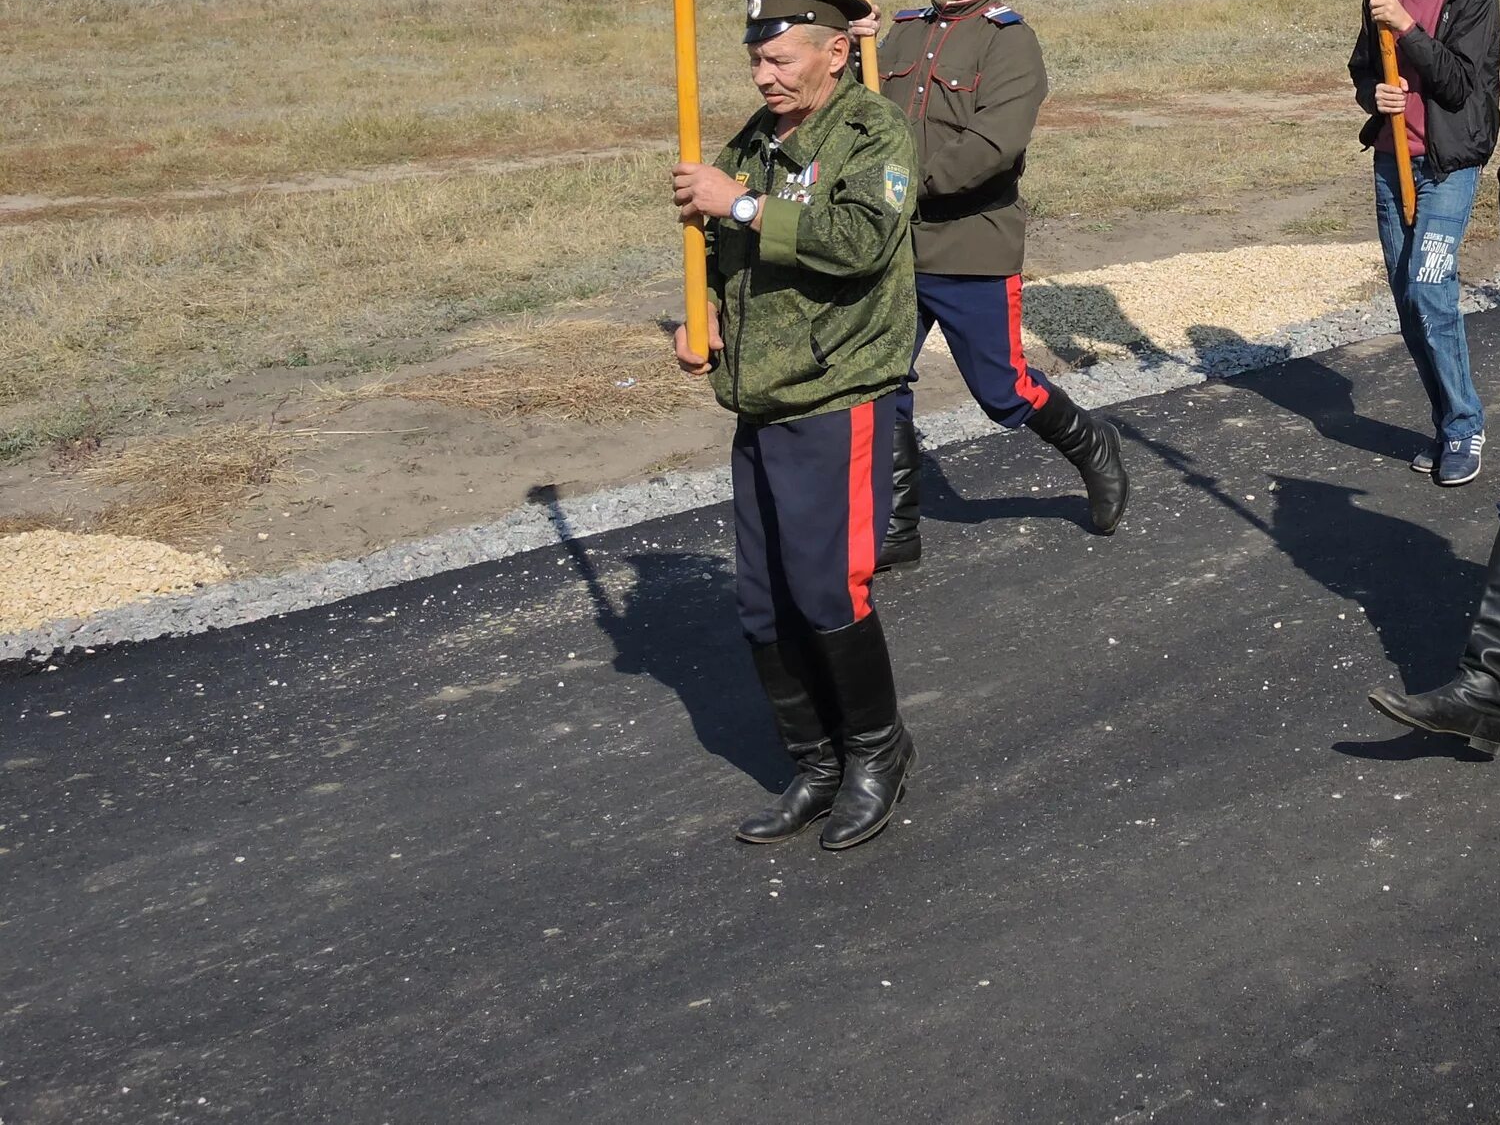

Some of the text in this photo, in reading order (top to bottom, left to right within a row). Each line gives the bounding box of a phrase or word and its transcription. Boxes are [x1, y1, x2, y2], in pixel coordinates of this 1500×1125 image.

[1420, 240, 1449, 254] CASUAL
[1425, 252, 1454, 271] WEAR
[1416, 267, 1445, 284] STYLE
